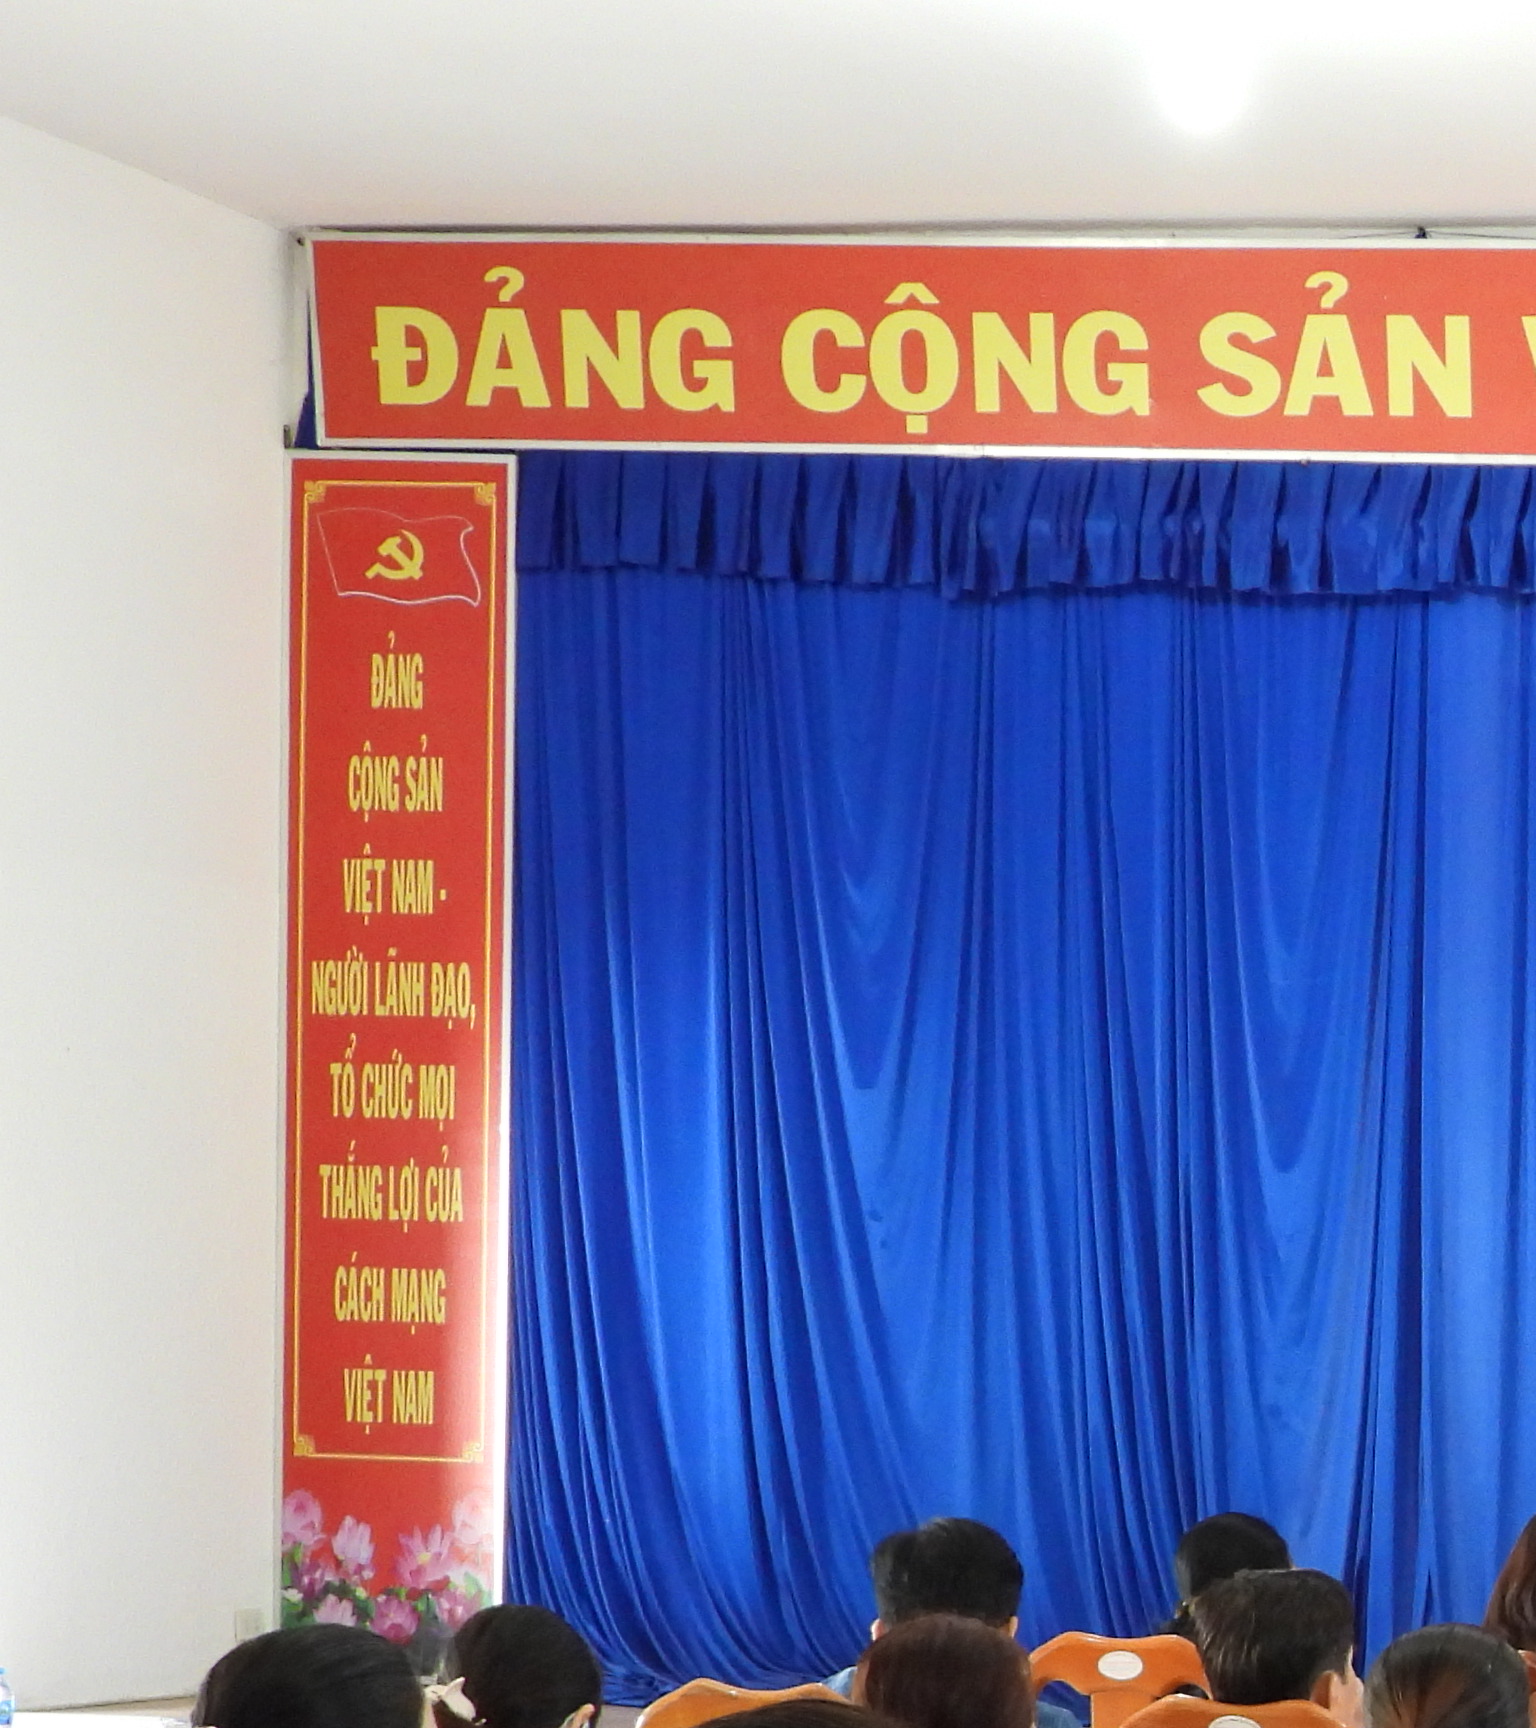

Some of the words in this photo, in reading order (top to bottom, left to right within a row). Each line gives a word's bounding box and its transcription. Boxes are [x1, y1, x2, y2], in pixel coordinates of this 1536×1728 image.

[371, 266, 735, 411] ĐẢNG
[781, 282, 1150, 434] CỘNG
[1195, 270, 1473, 416] SẢN
[371, 631, 424, 710] ĐẢNG
[348, 740, 400, 821] CỘNG
[405, 734, 443, 813] SẢN
[343, 843, 386, 924] VIỆT
[391, 859, 434, 915] NAM
[312, 945, 368, 1016] NGƯỜI
[374, 947, 425, 1017] LÃNH
[430, 962, 476, 1030] ĐẠO,
[330, 1033, 356, 1118] TỔ
[361, 1049, 414, 1120] CHỨC
[418, 1064, 456, 1131] MỌI
[319, 1140, 383, 1221] THẮNG
[387, 1158, 422, 1232] LỢI
[422, 1144, 463, 1224] CỦA
[334, 1251, 385, 1323] CÁCH
[390, 1268, 447, 1335] MẠNG
[344, 1354, 387, 1434] VIỆT
[392, 1370, 435, 1425] NAM
